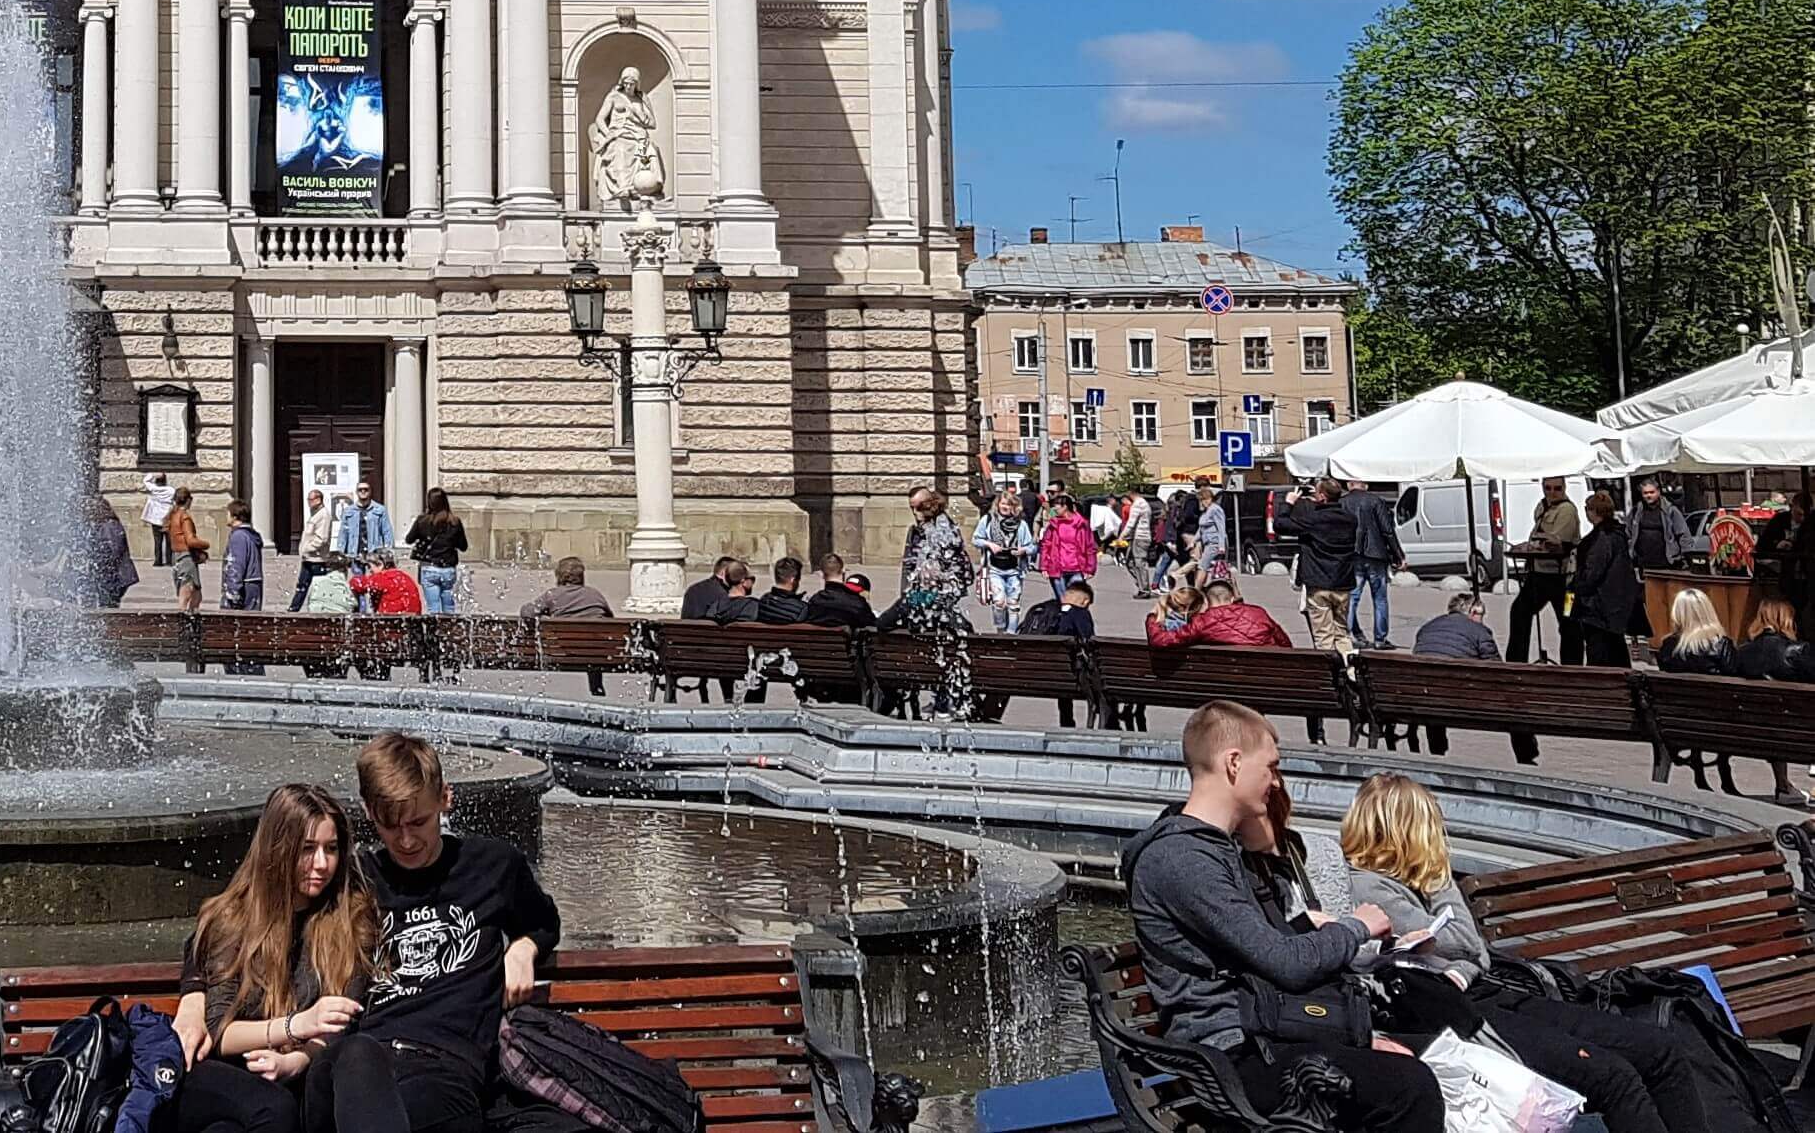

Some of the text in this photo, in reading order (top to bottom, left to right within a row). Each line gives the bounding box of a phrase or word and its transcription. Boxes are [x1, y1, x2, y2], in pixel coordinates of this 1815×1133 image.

[284, 5, 374, 32] КОЛИ ЦВІТЕ
[289, 32, 369, 58] ПАПОРОТЬ
[282, 175, 377, 188] ВАСИЛЬ ВОВКУН
[287, 187, 340, 199] Український
[1227, 435, 1244, 463] P
[405, 905, 438, 922] 1661
